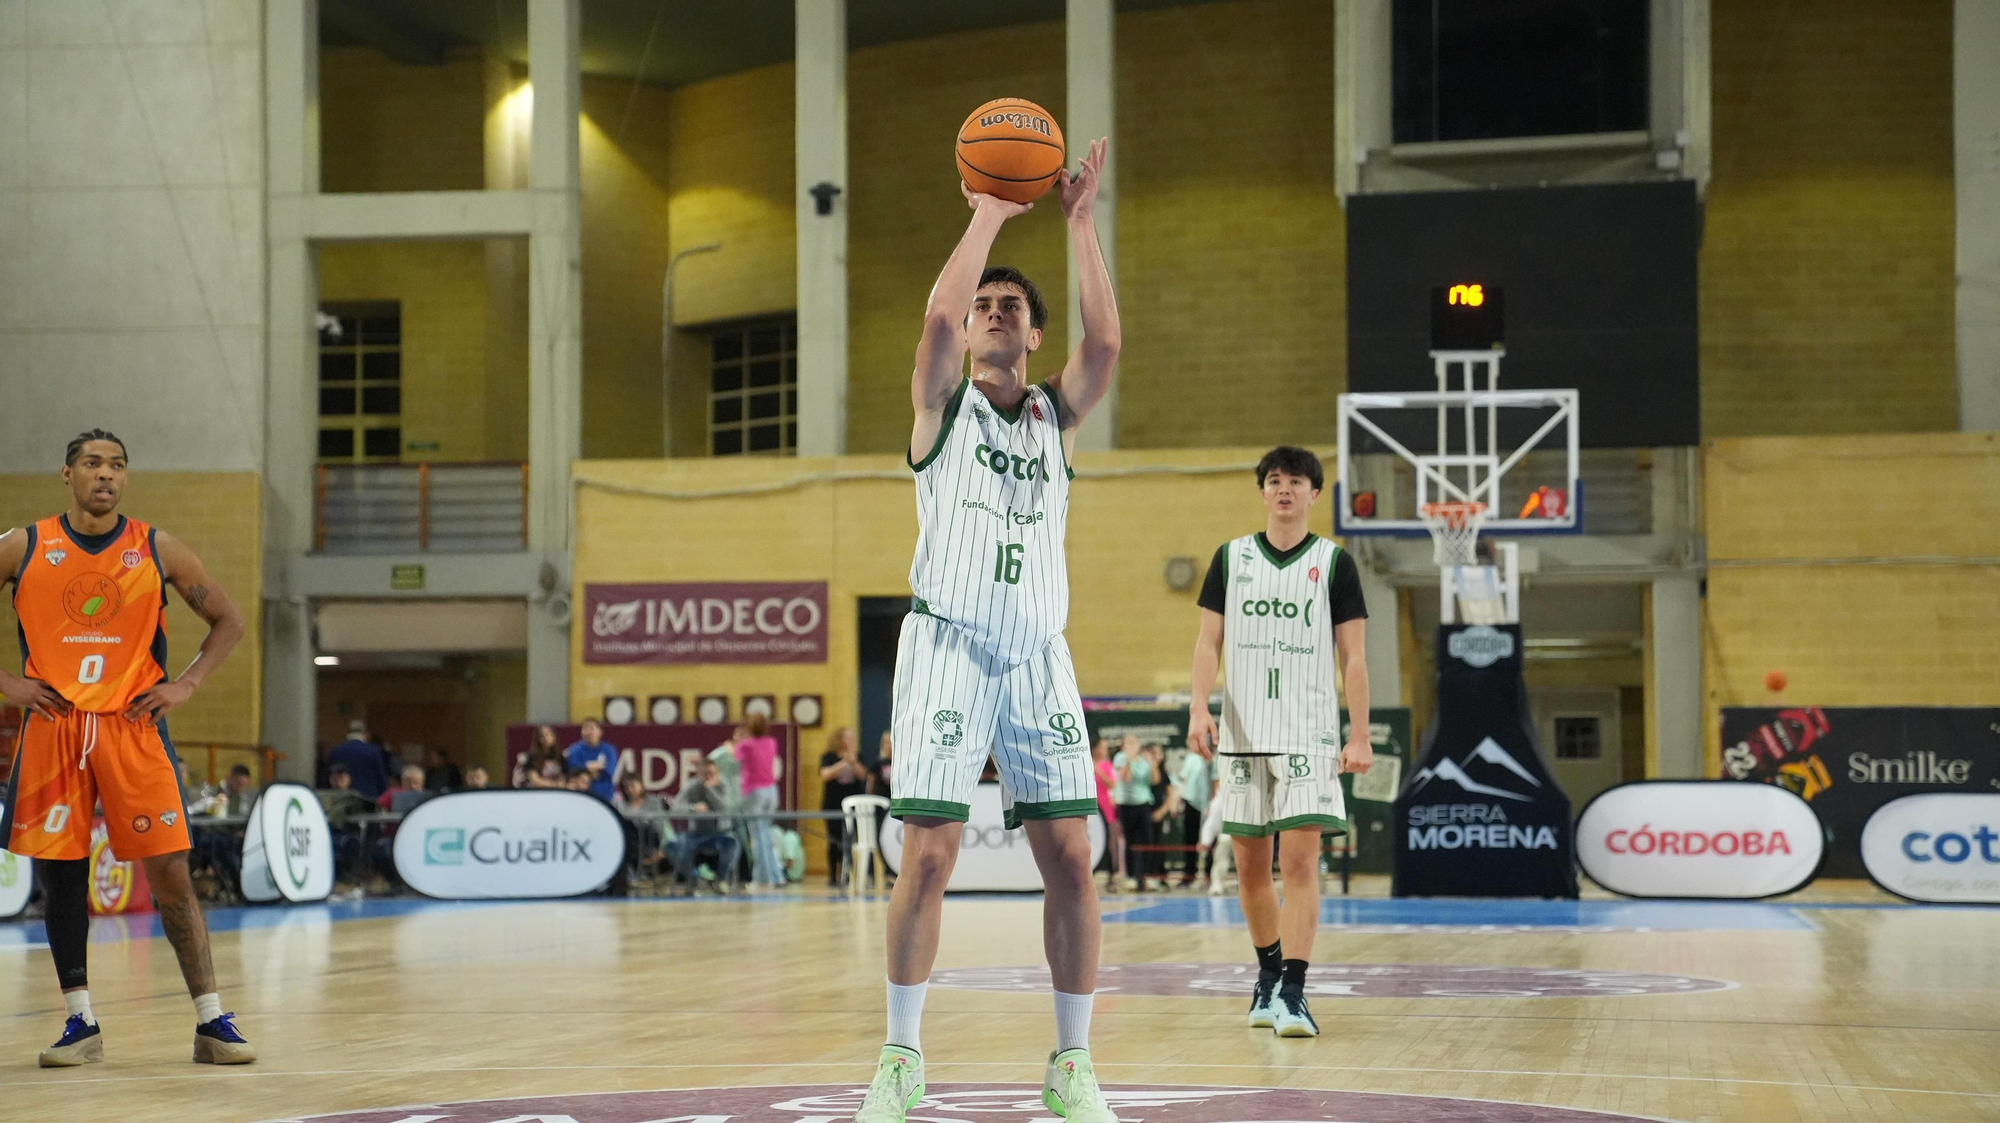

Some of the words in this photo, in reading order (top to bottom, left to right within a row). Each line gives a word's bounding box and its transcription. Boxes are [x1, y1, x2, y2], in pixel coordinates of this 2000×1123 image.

[980, 113, 1053, 138] Wilson
[961, 499, 1005, 521] Fundación
[1012, 509, 1044, 526] Caja
[994, 542, 1024, 585] 16
[645, 597, 821, 636] IMDECO
[62, 635, 121, 644] AVISERRANO
[78, 654, 104, 685] 0
[1268, 668, 1279, 699] 11
[1043, 745, 1088, 757] SohoBoutiqu
[1849, 751, 1970, 784] Smilke
[43, 804, 71, 834] 0
[1408, 803, 1508, 827] SIERRA
[469, 827, 592, 864] Cualix
[1408, 824, 1559, 850] MORENA
[1605, 823, 1792, 856] CÓRDOBA
